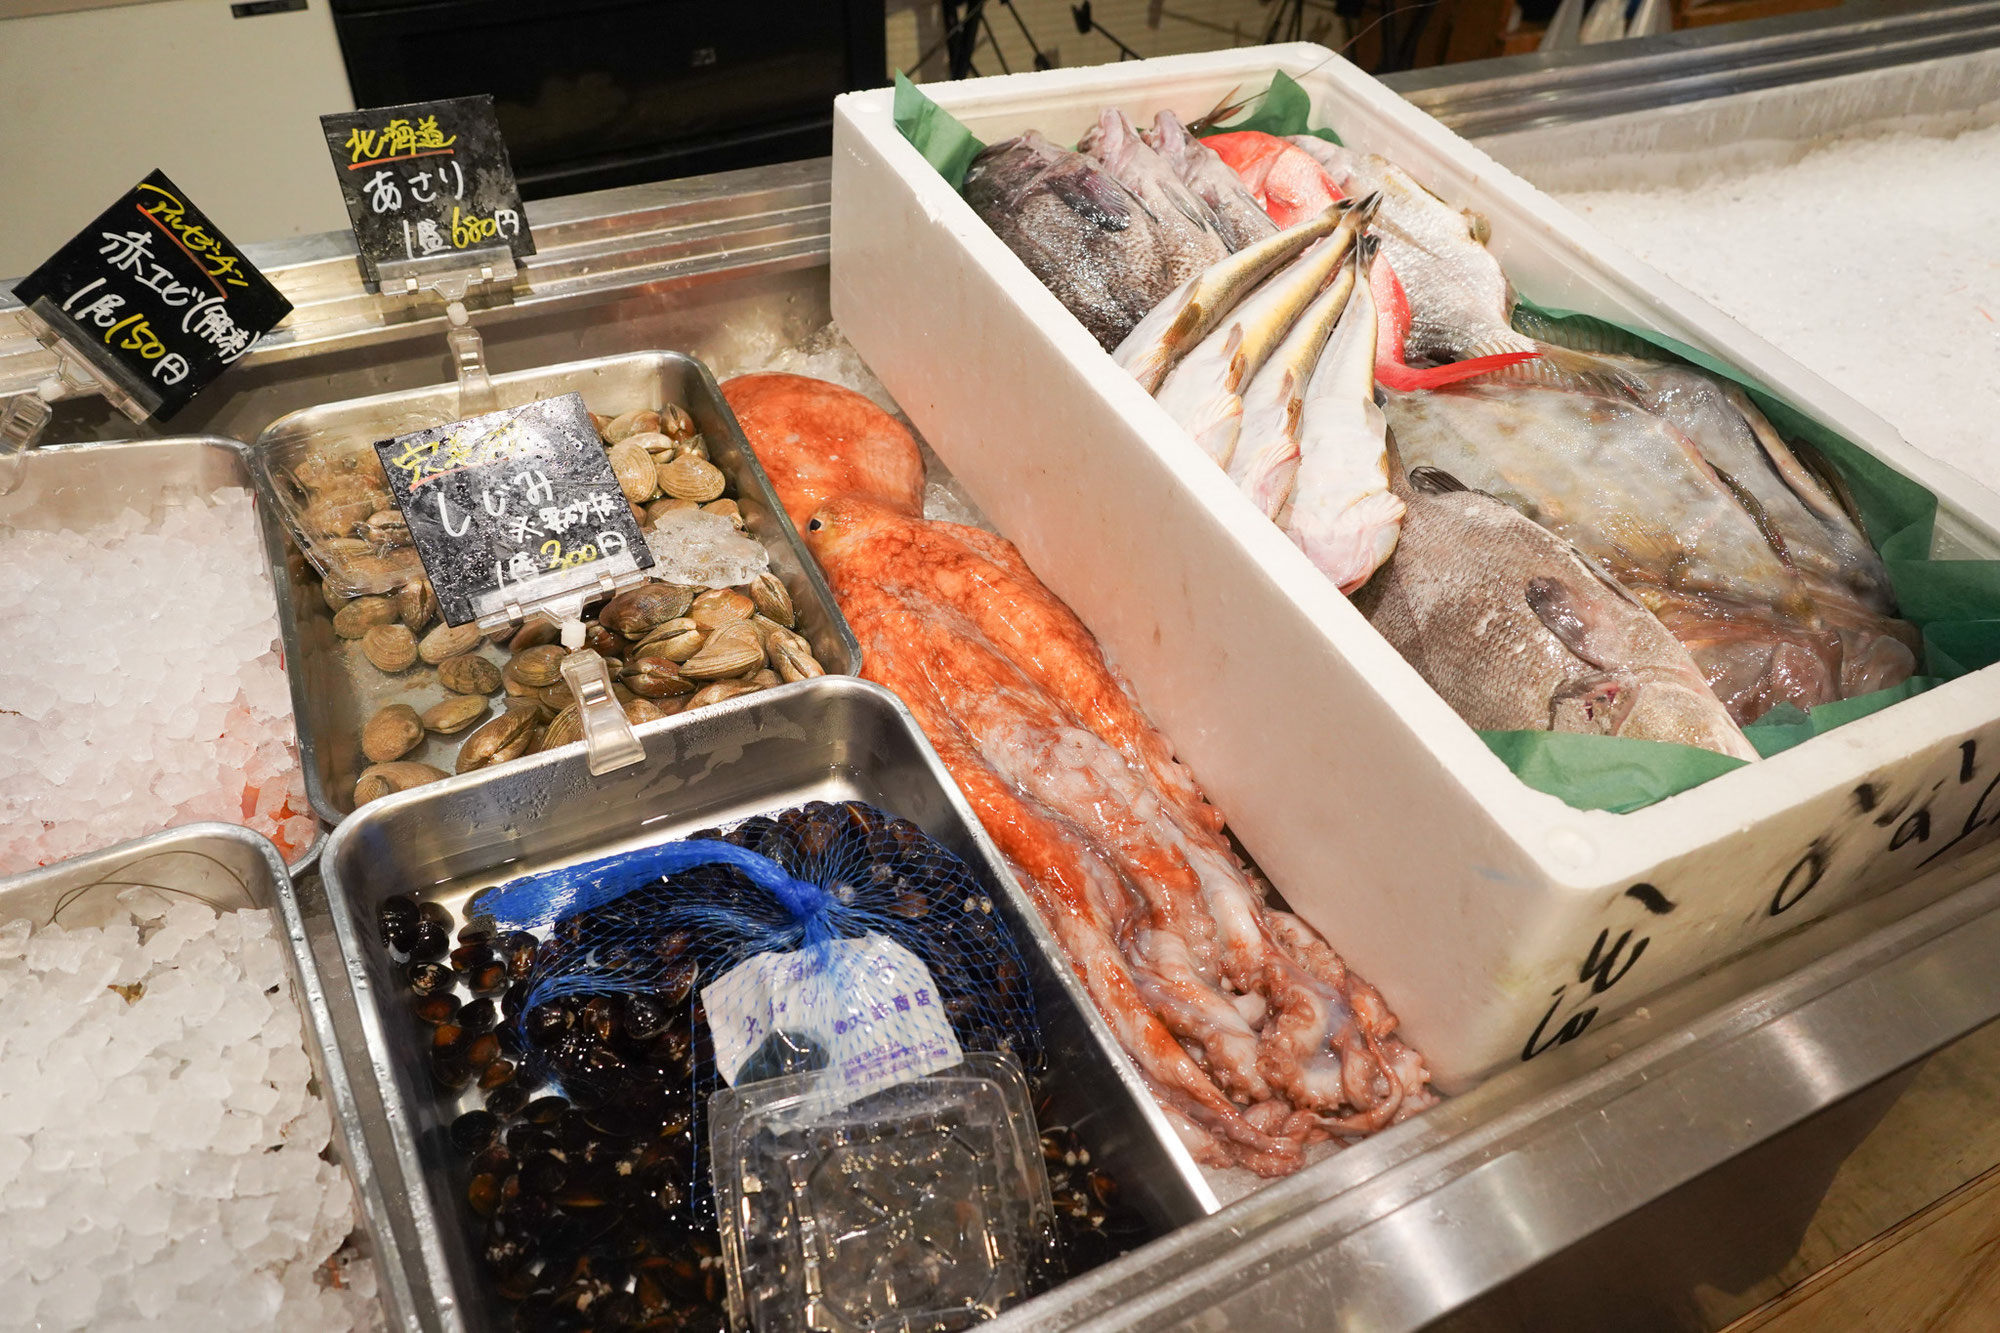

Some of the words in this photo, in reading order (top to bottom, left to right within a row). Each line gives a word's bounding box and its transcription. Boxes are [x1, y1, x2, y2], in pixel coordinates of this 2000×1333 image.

[345, 115, 457, 163] 北海道
[363, 160, 464, 213] あさり
[437, 470, 554, 537] しじみ
